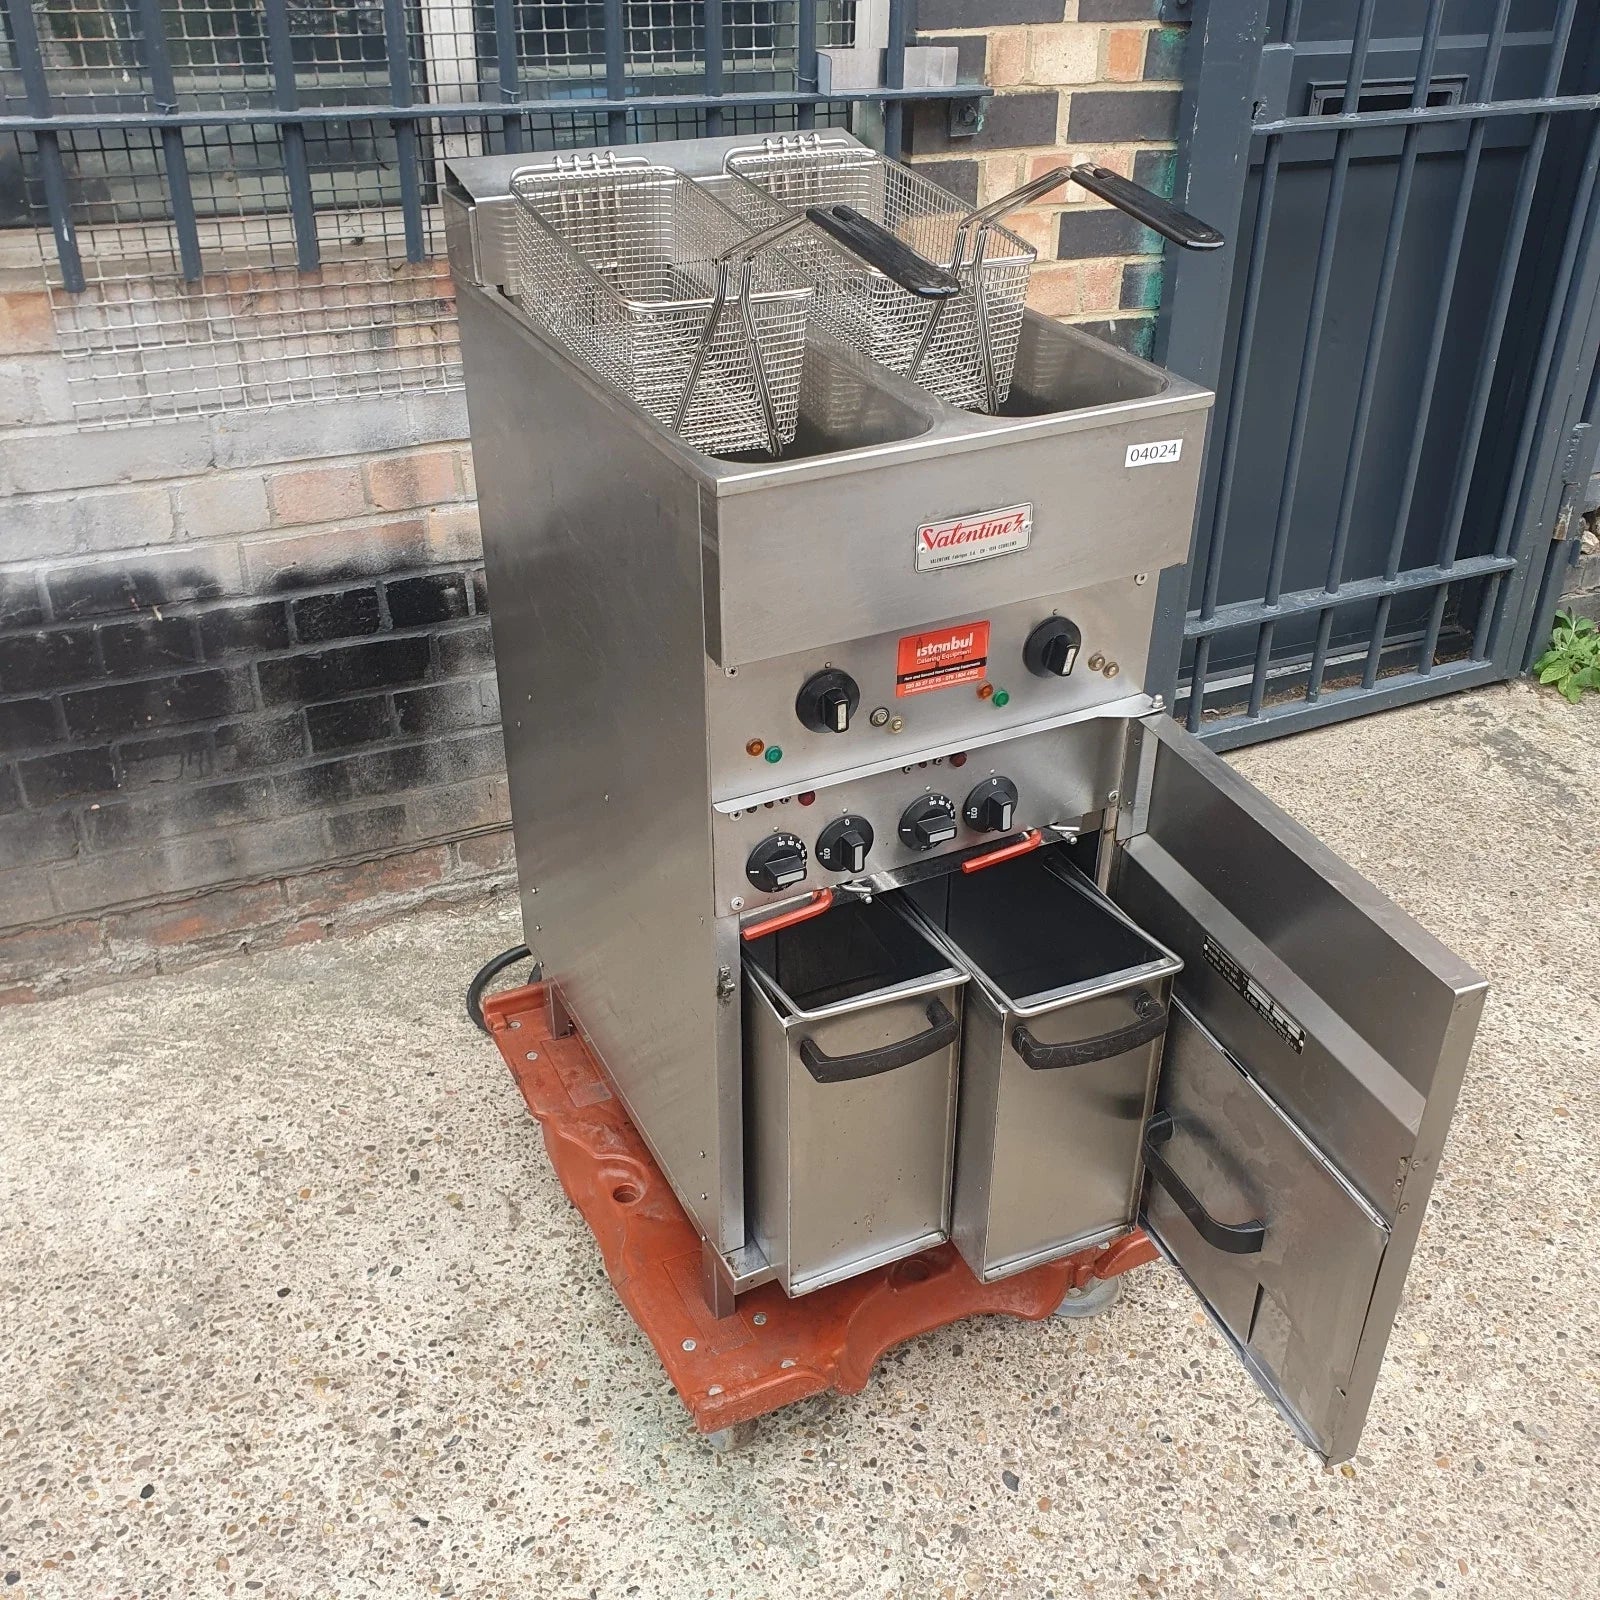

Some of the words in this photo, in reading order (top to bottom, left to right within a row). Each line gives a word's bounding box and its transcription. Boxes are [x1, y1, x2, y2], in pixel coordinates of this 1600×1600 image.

[1130, 443, 1178, 462] 04024
[922, 519, 1014, 550] Valentine
[916, 632, 974, 657] istanbul
[916, 654, 940, 665] Catering
[941, 648, 972, 660] Equipment
[970, 807, 978, 819] ECO
[823, 848, 831, 860] ECO
